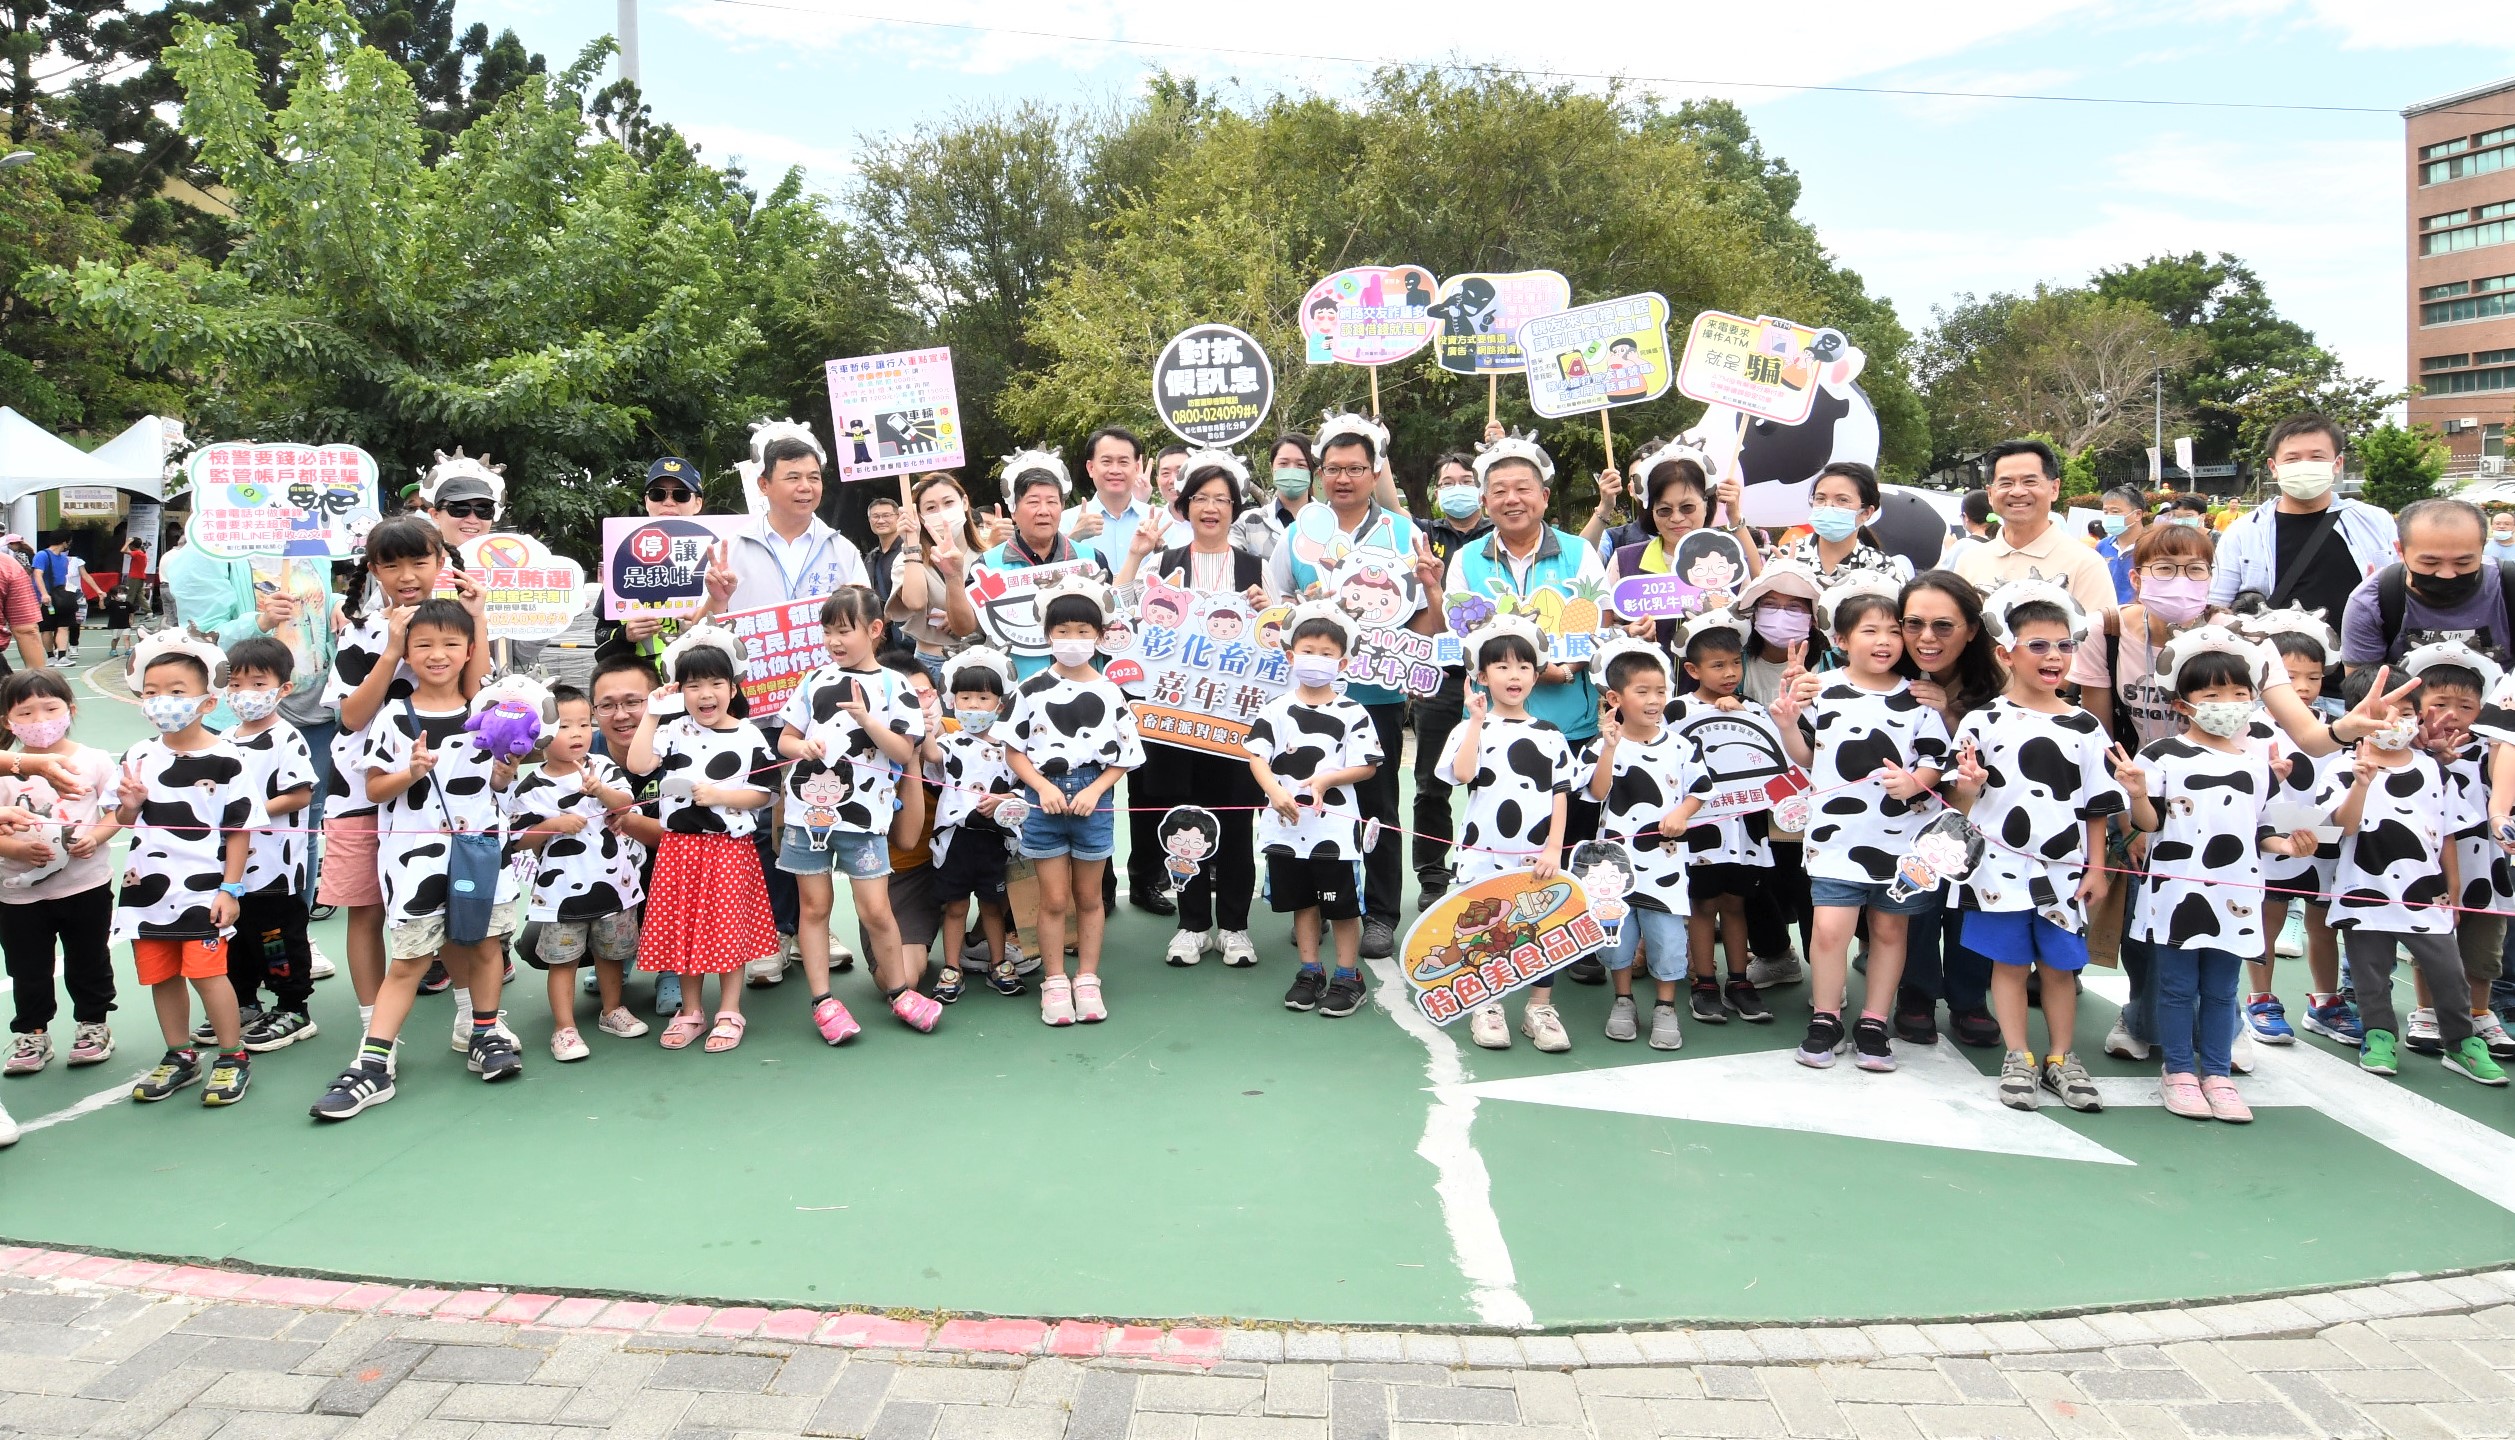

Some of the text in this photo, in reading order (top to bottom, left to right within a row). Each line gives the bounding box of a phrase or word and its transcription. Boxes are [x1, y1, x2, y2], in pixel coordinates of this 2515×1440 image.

[1707, 319, 1750, 338] 來電要求
[1771, 320, 1792, 330] ATM
[1702, 329, 1749, 348] 操作ATM
[1178, 336, 1243, 366] 對抗
[1164, 365, 1260, 396] 假訊息
[908, 408, 934, 420] 車輛
[1172, 404, 1259, 424] 0800-024099#4
[208, 449, 359, 466] 檢警要錢必詐騙
[209, 468, 360, 484] 監管帳戶都是騙
[202, 520, 291, 530] 不會要求去超商
[202, 529, 332, 541] 或使用LINE接收公文書
[623, 564, 705, 589] 是我唯一
[1641, 582, 1676, 595] 2023
[632, 600, 699, 609] 彰化縣警察局
[1623, 595, 1695, 613] 彰化乳牛節
[1141, 626, 1290, 684] 彰化畜產
[1109, 667, 1139, 680] 2023
[1152, 671, 1268, 720] 嘉年華
[2123, 684, 2173, 704] STA
